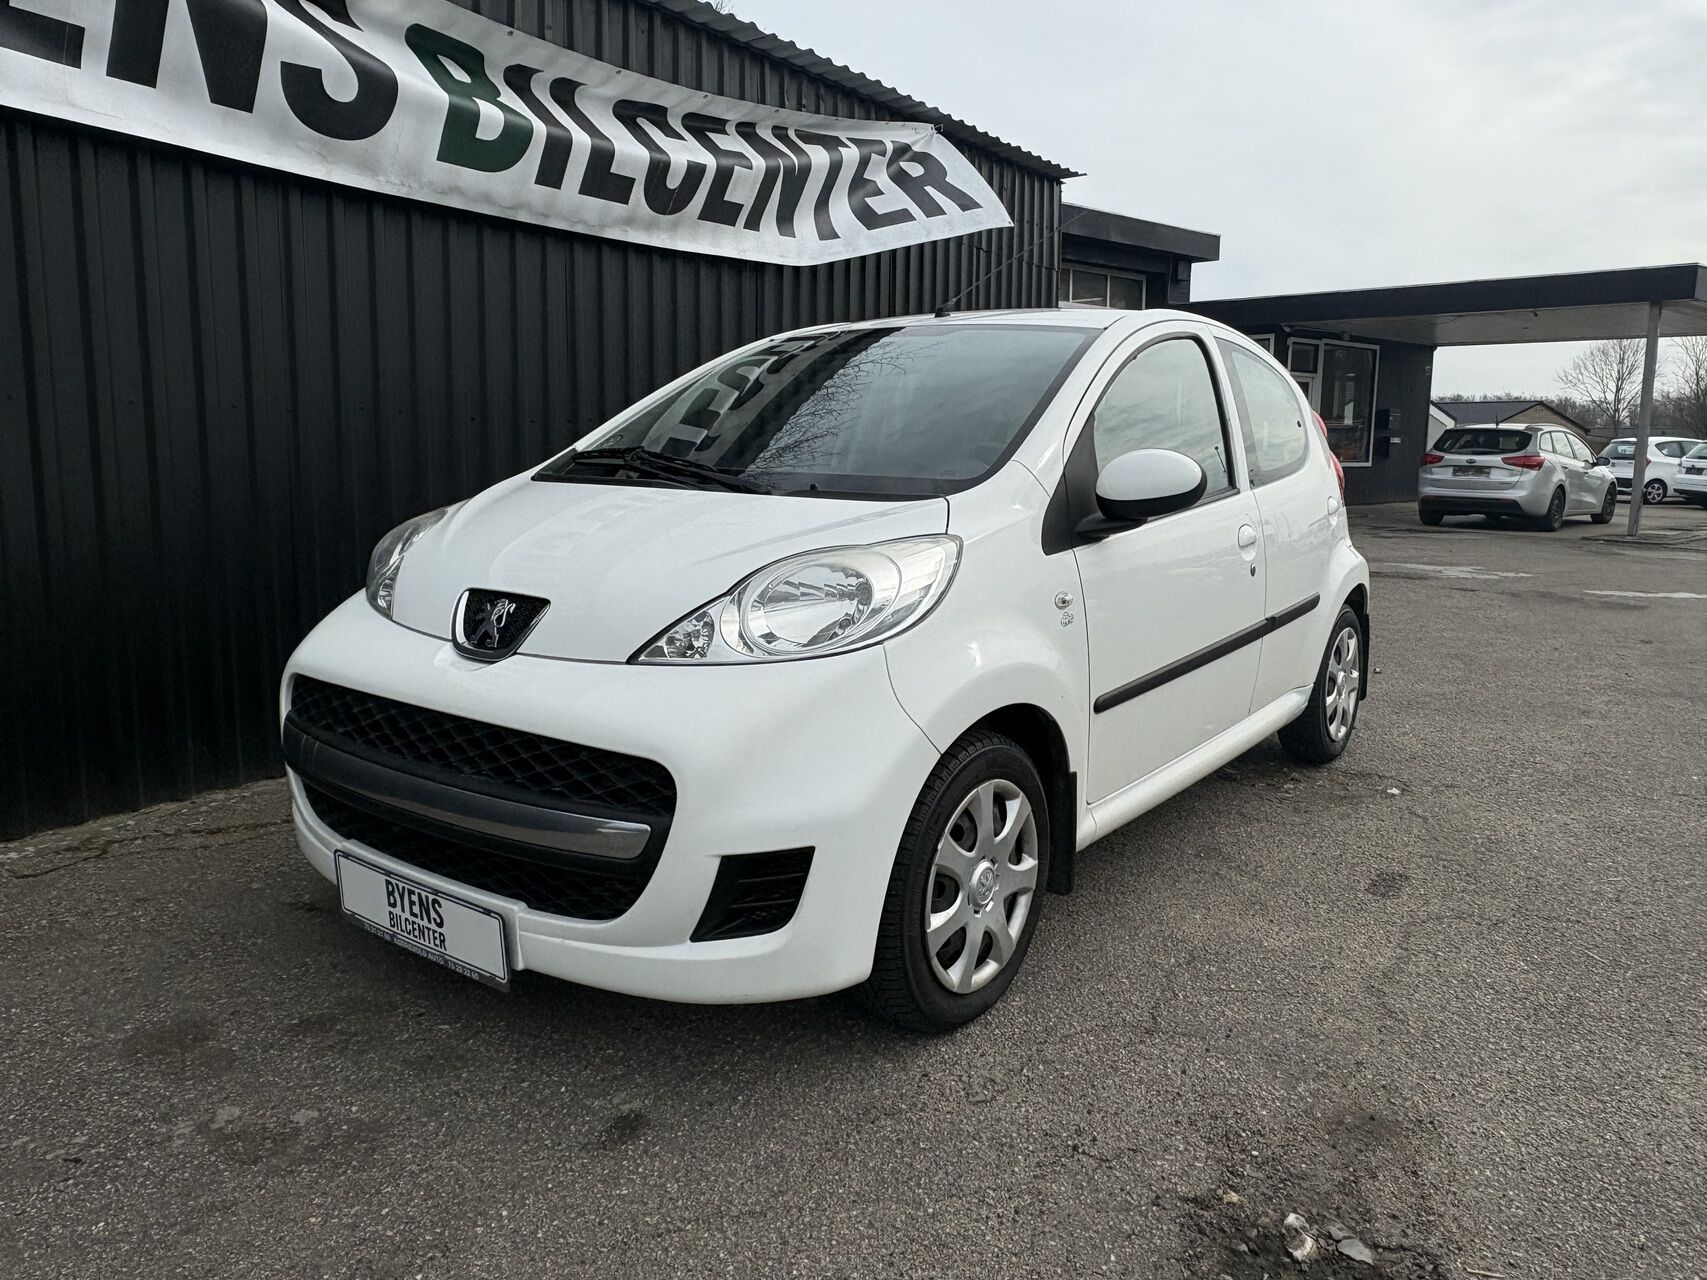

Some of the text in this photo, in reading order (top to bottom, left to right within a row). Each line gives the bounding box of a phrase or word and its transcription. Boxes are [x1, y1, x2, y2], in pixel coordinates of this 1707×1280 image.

[404, 22, 984, 242] BILCENTER
[385, 878, 445, 930] BYENS
[389, 910, 447, 952] BILCENTER
